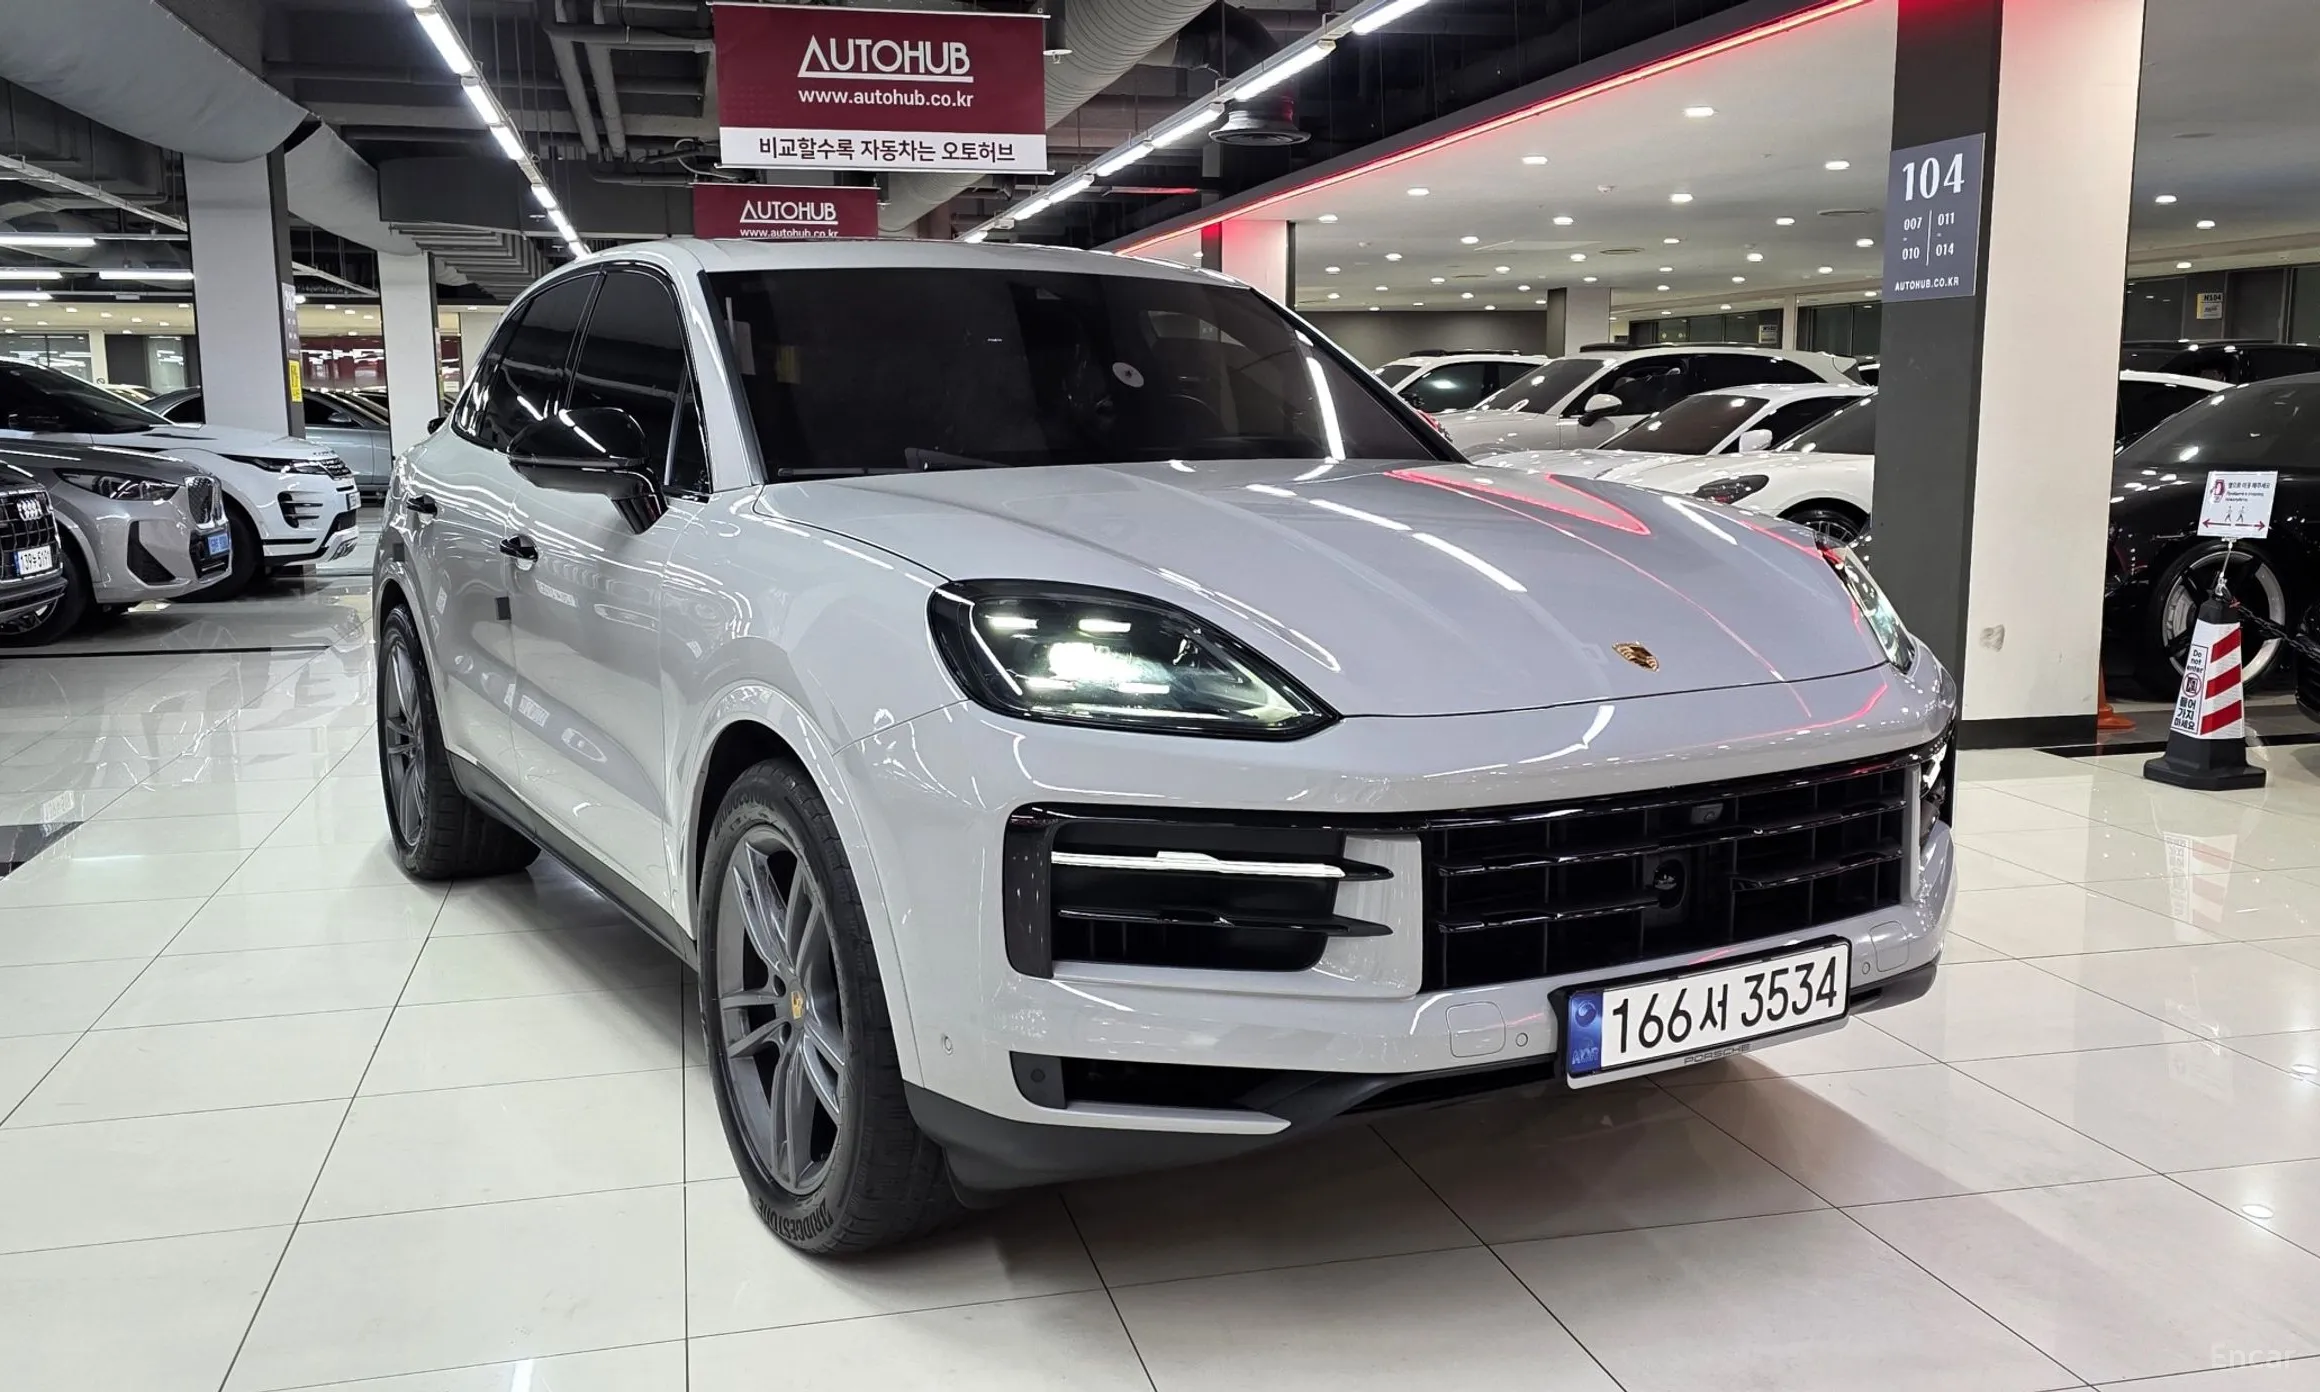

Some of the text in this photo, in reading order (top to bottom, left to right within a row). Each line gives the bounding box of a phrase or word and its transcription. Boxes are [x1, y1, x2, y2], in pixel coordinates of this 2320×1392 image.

[798, 35, 974, 82] AUTOHUB
[798, 89, 974, 107] www.autohub.co.kr
[759, 137, 1016, 163] 비교할수록 자동차는 오토허브
[1902, 153, 1965, 201] 104
[740, 200, 838, 225] AUTOHUB
[1938, 212, 1955, 226] 011
[1904, 217, 1922, 230] 007
[1902, 247, 1920, 260] 010
[1935, 243, 1954, 257] 014
[1894, 276, 1960, 291] AUTOHUB.CO.KR
[2193, 649, 2203, 657] Do
[2177, 708, 2195, 720] 가지
[1612, 956, 1837, 1053] 166서 3534
[1684, 1043, 1752, 1065] PORSCHE
[758, 1197, 834, 1241] BRIDGESTONE
